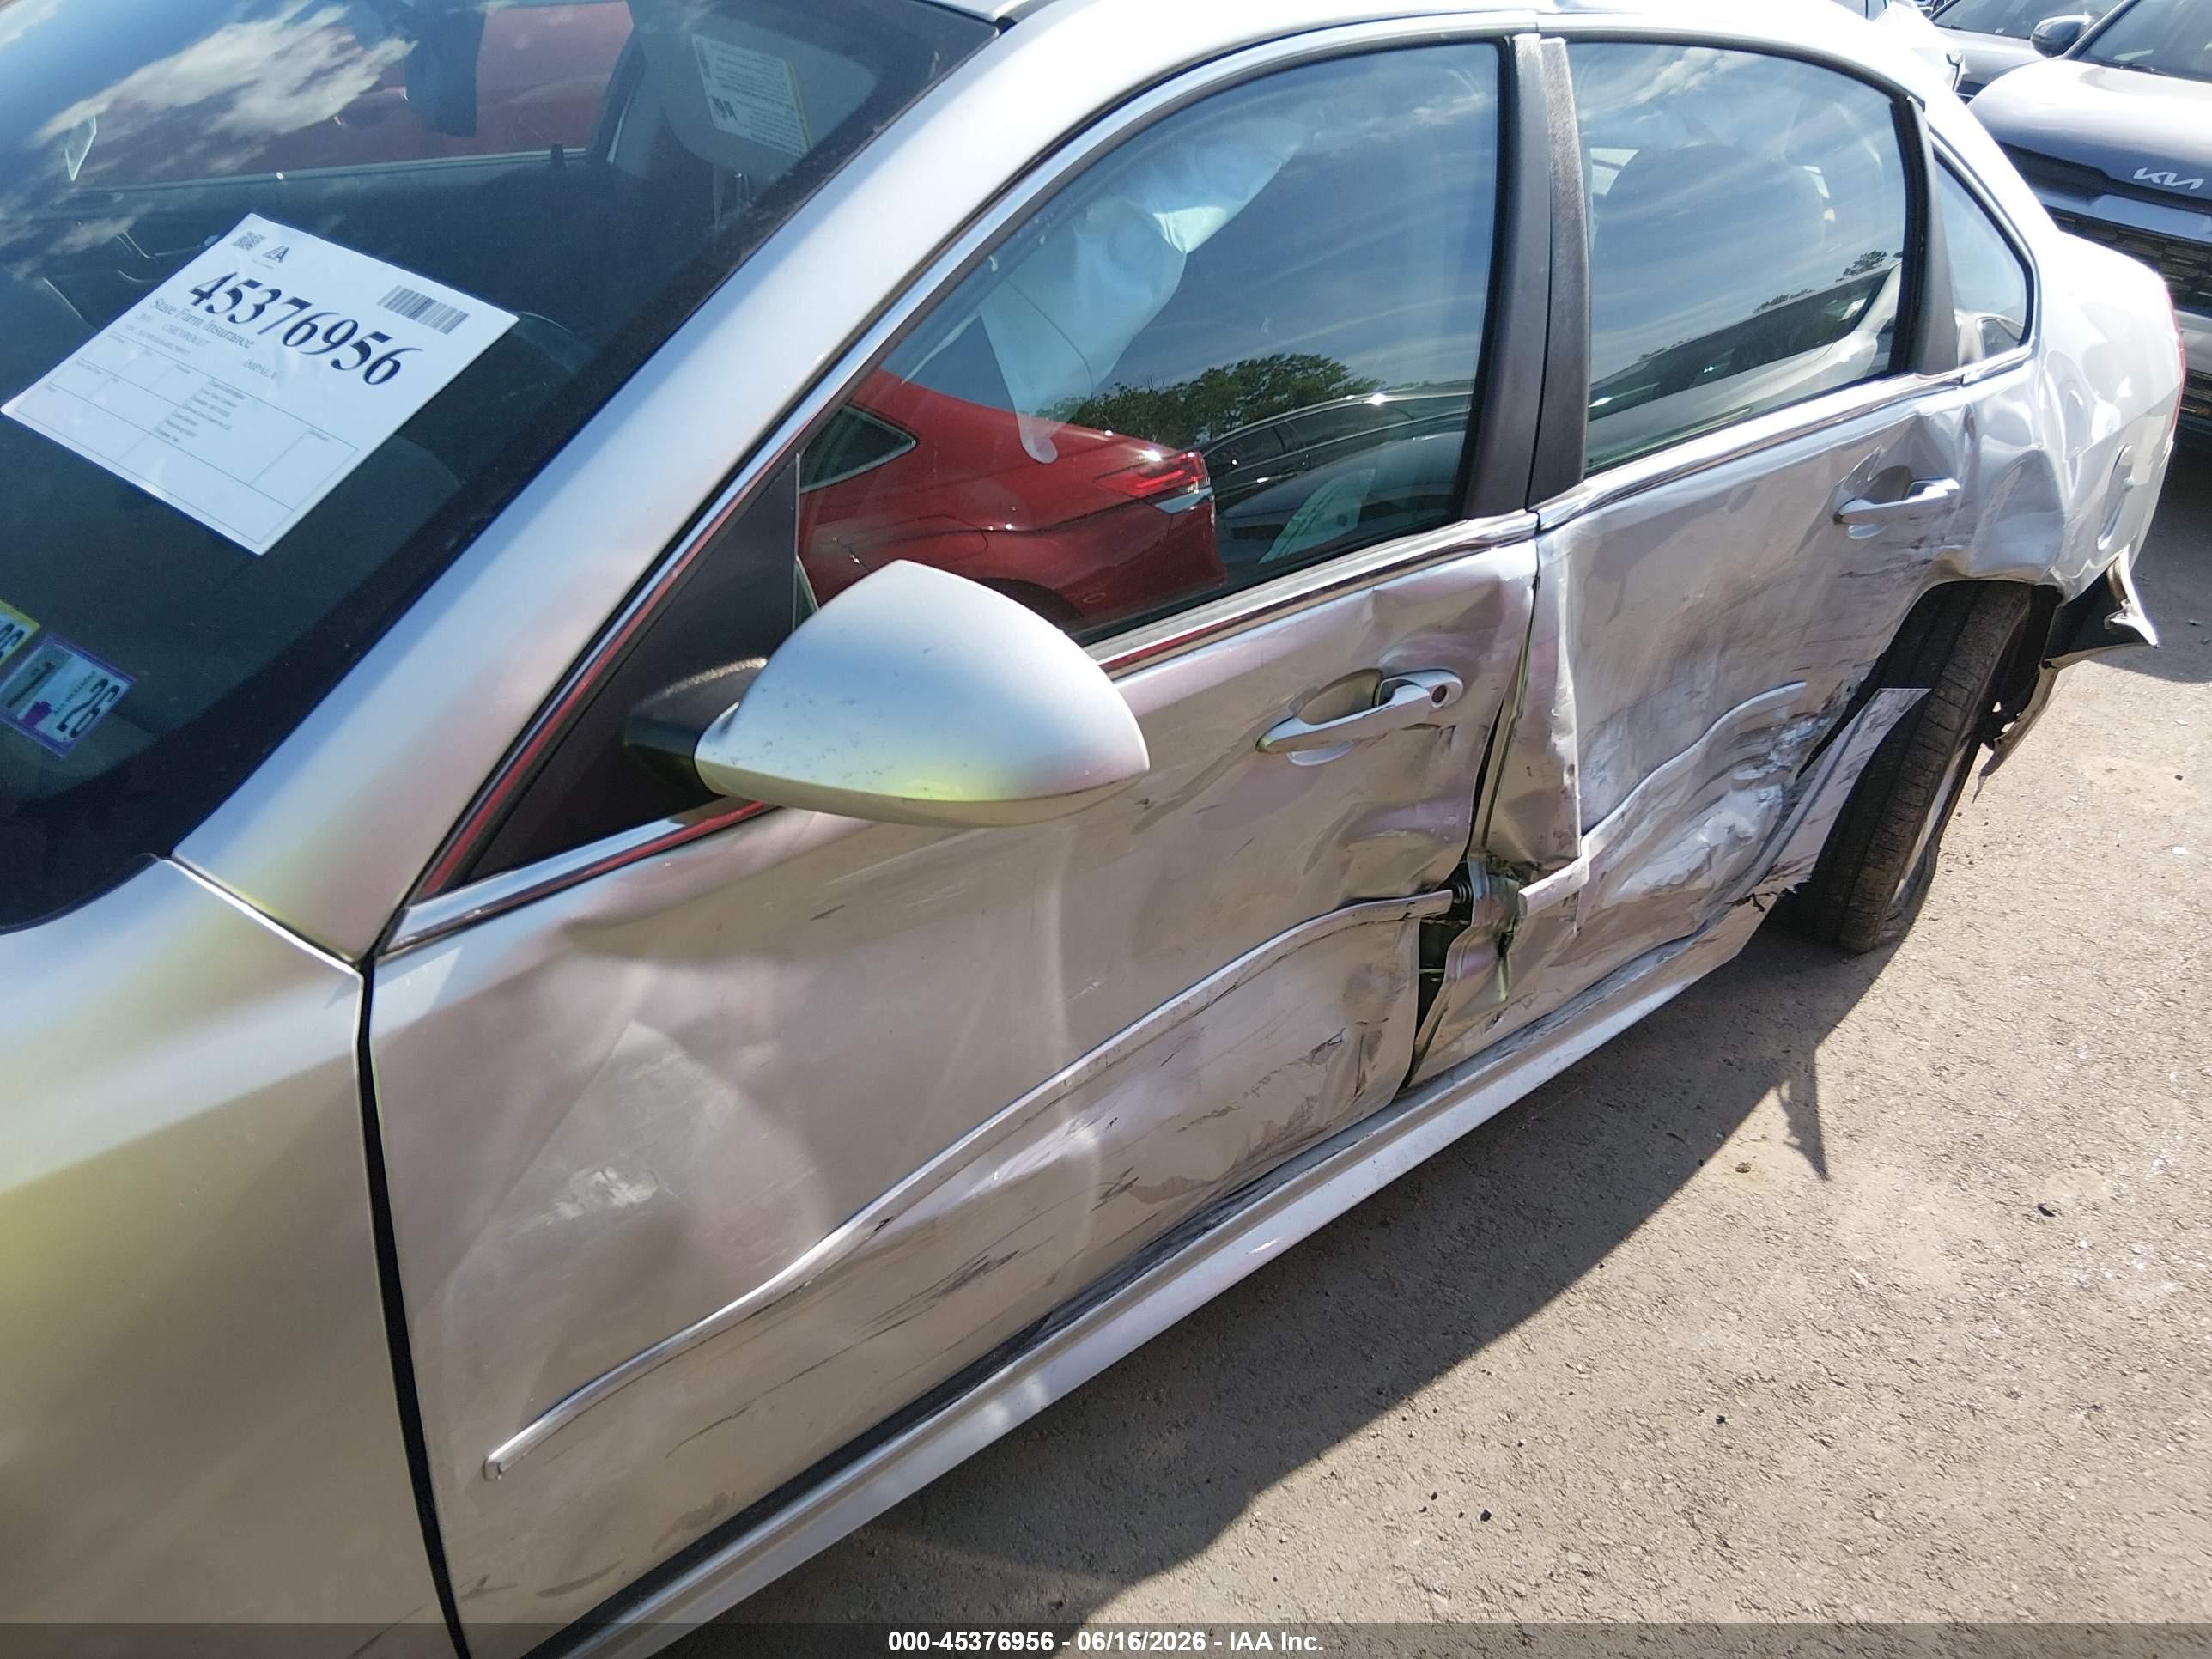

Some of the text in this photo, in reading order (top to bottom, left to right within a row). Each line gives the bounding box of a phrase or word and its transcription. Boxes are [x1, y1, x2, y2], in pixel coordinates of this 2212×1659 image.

[149, 297, 178, 316] State
[175, 307, 203, 328] Farm
[203, 319, 255, 349] Insurance
[189, 271, 424, 385] 45376956
[56, 678, 120, 738] 26
